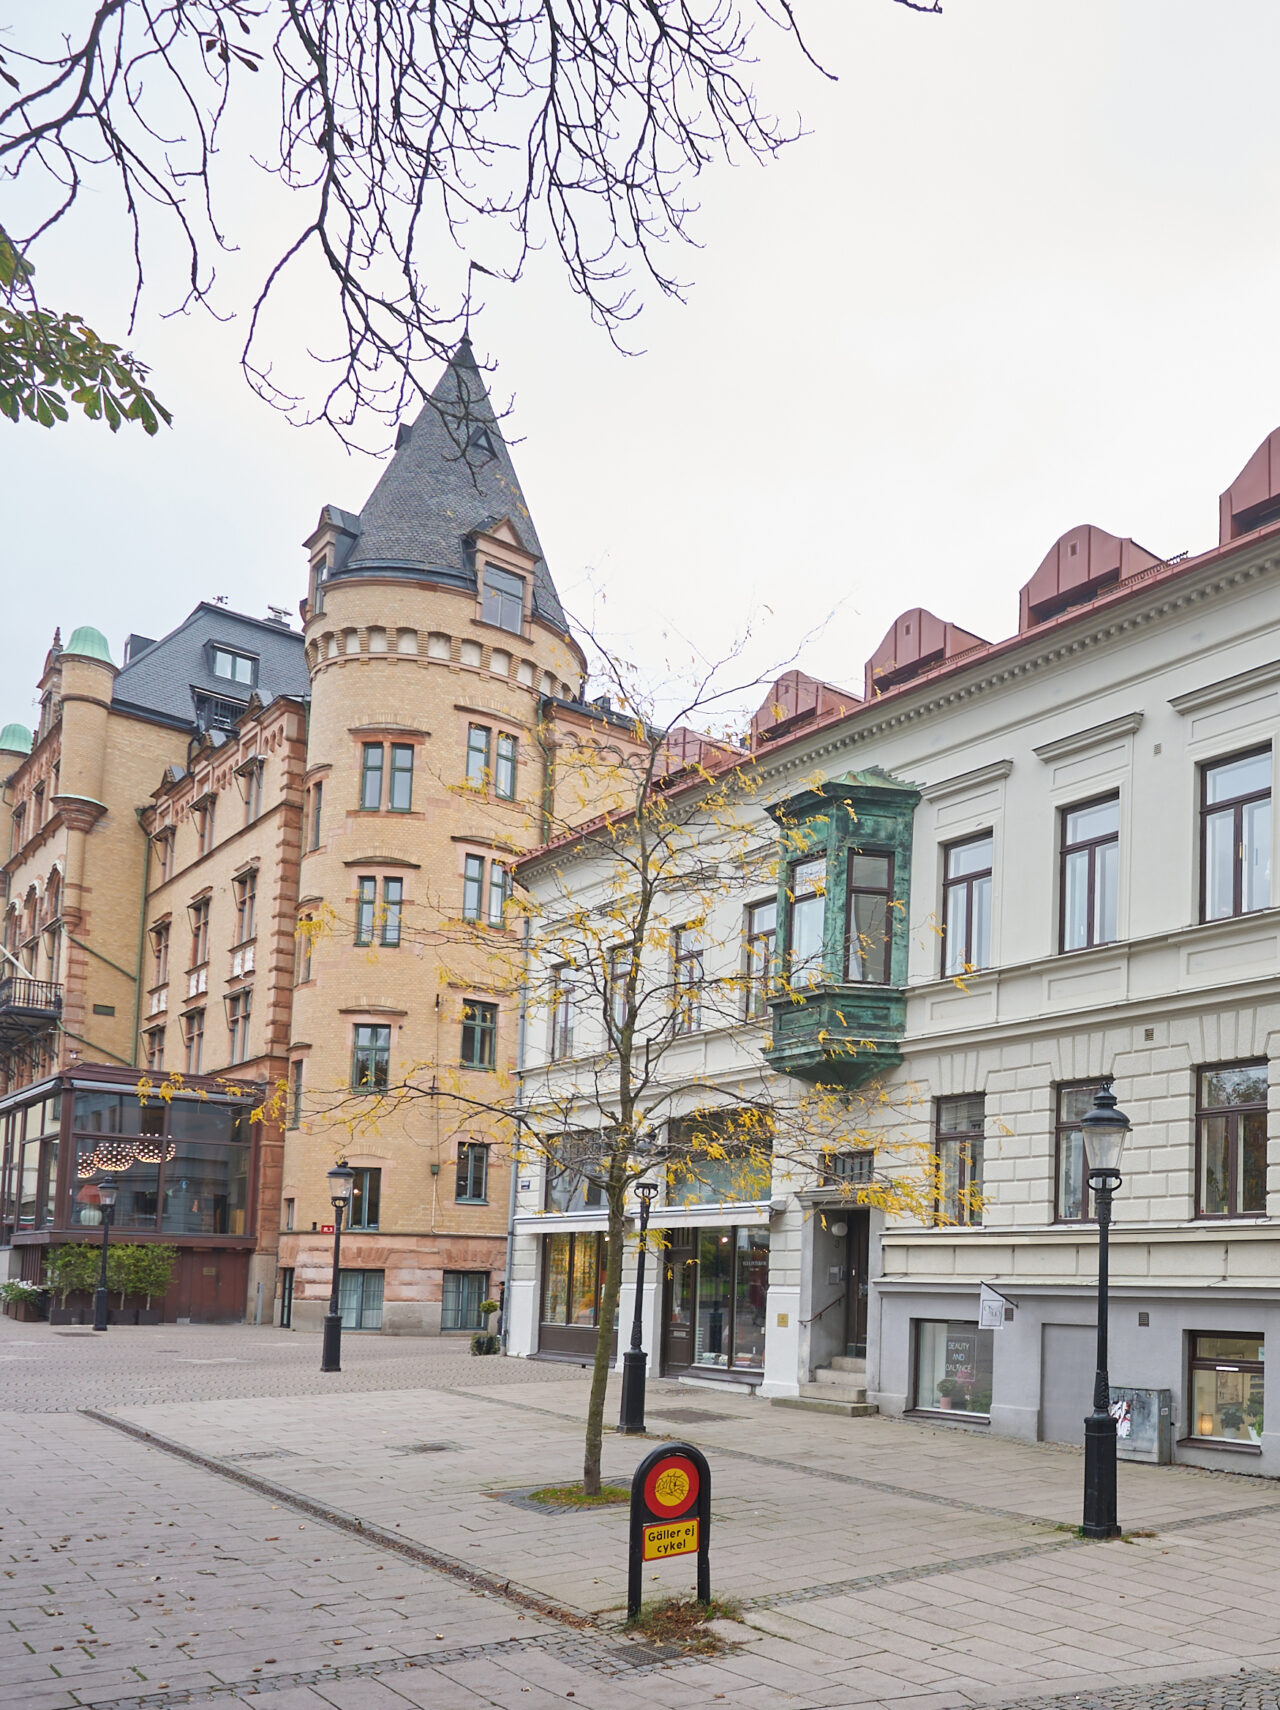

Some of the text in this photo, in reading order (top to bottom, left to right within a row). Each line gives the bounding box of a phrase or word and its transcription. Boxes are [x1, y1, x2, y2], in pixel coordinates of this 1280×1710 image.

[947, 1341, 970, 1350] BEAUTY
[952, 1353, 965, 1361] AND
[648, 1524, 695, 1542] Gäller ej
[656, 1538, 686, 1554] cykel
